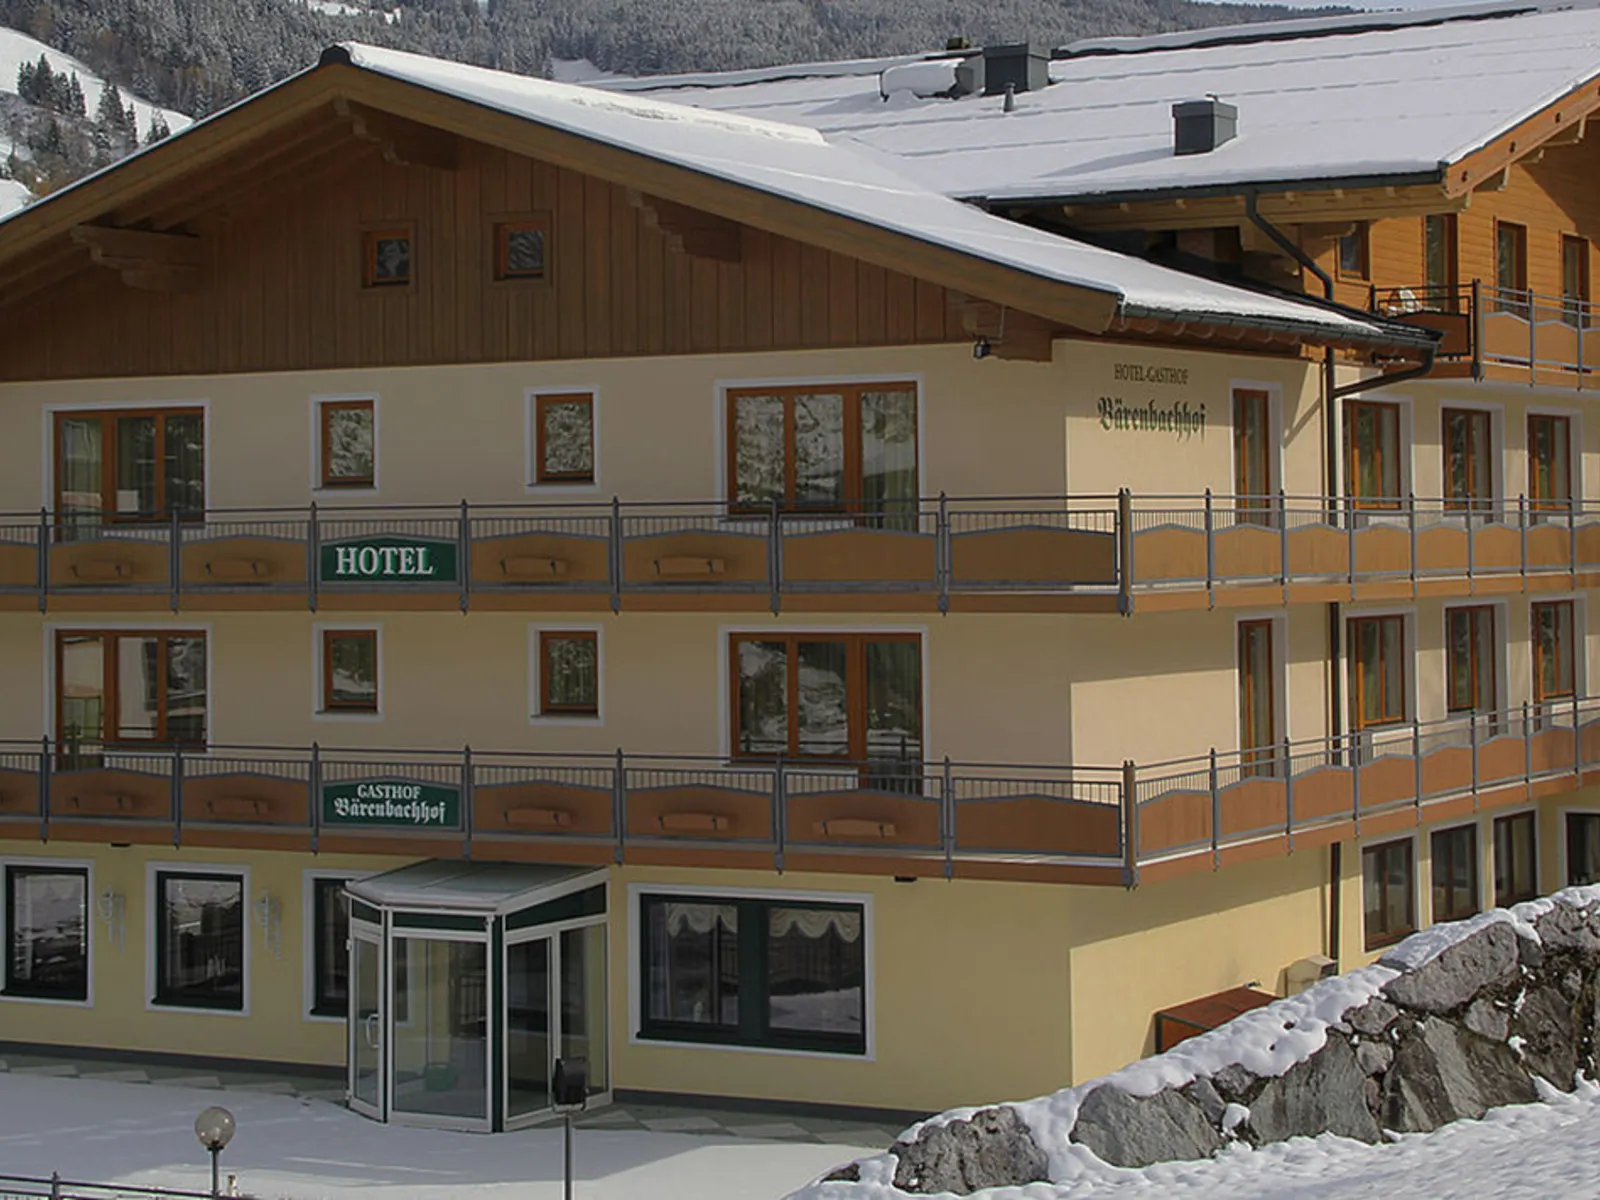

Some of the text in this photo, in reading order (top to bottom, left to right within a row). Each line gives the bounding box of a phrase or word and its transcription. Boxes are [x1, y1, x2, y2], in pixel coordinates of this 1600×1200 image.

[1097, 397, 1207, 443] Bärenbachhof
[335, 546, 434, 575] HOTEL
[357, 784, 421, 799] GASTHOF
[333, 797, 446, 824] Bärenbachhof
